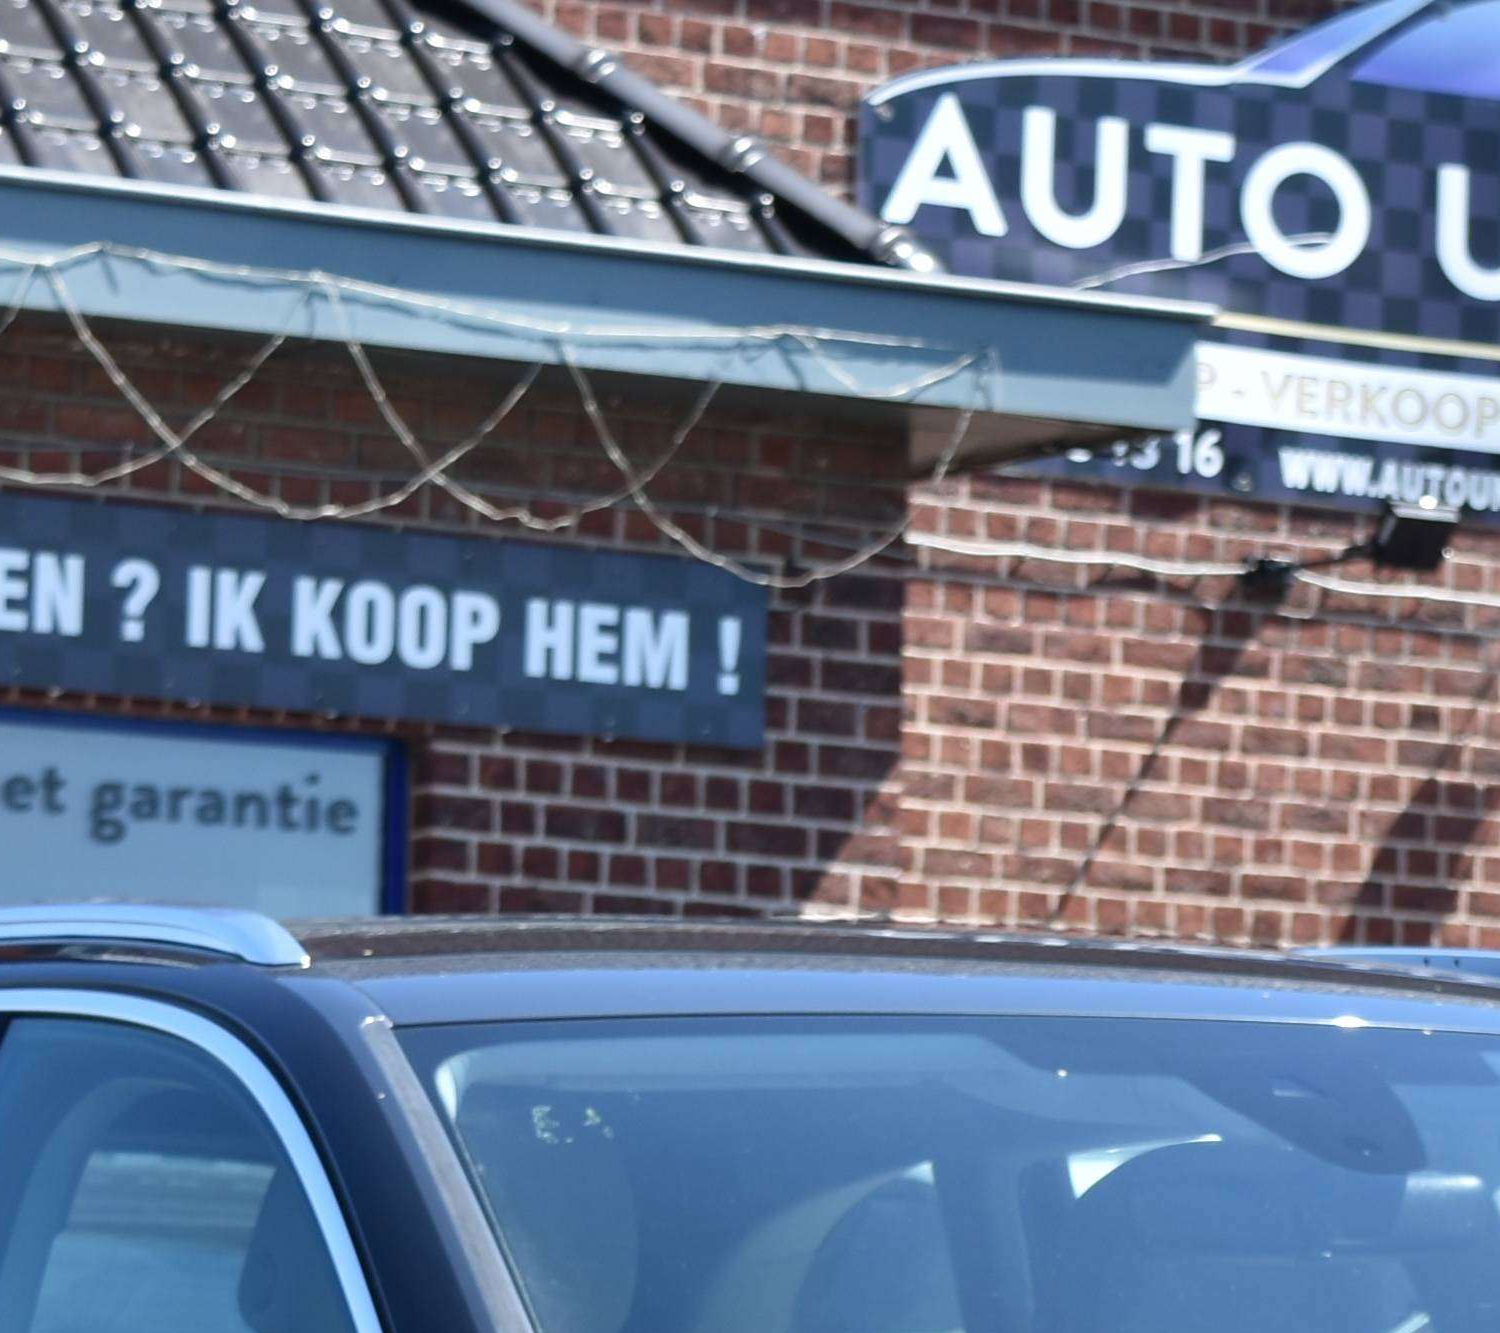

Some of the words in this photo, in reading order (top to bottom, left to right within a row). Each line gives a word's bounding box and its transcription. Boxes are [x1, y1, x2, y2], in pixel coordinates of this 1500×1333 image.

[880, 91, 1372, 280] AUTO
[1260, 370, 1500, 437] VERKOOP
[186, 565, 267, 653] IK
[291, 576, 502, 671] KOOP
[523, 598, 690, 692] HEM
[91, 772, 359, 844] garantie
